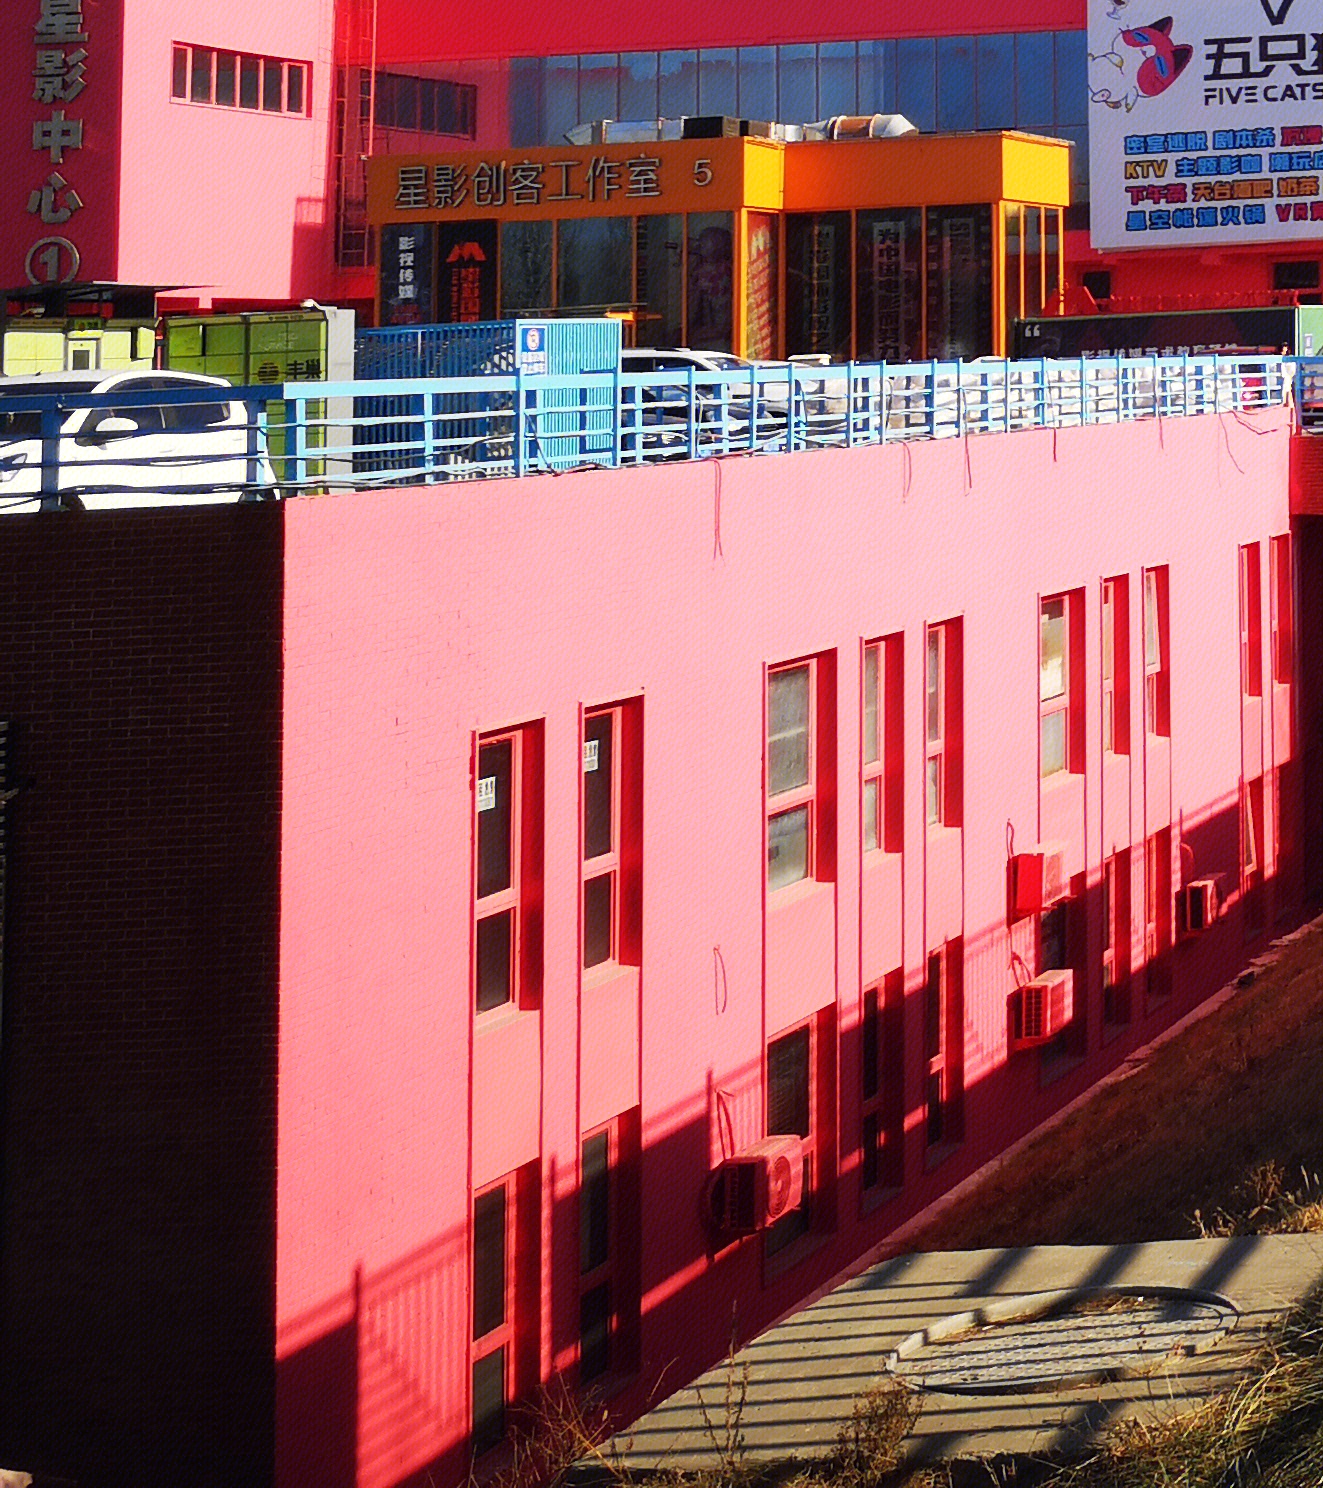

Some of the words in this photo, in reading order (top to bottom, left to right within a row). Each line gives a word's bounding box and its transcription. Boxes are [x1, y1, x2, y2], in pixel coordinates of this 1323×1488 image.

[1203, 85, 1258, 106] FIVE
[1124, 131, 1208, 155] 密室逃脱
[1212, 126, 1276, 150] 剧本杀
[394, 153, 662, 210] 星影创客工作室
[692, 159, 713, 187] 5
[1124, 158, 1168, 179] KTV
[1124, 183, 1187, 205] 下午茶
[1192, 178, 1274, 202] 天台酒吧
[1277, 176, 1320, 198] 奶茶
[1125, 202, 1266, 231] 星空帐篷火锅
[398, 235, 416, 299] 影视传媒
[285, 357, 322, 380] 丰巢
